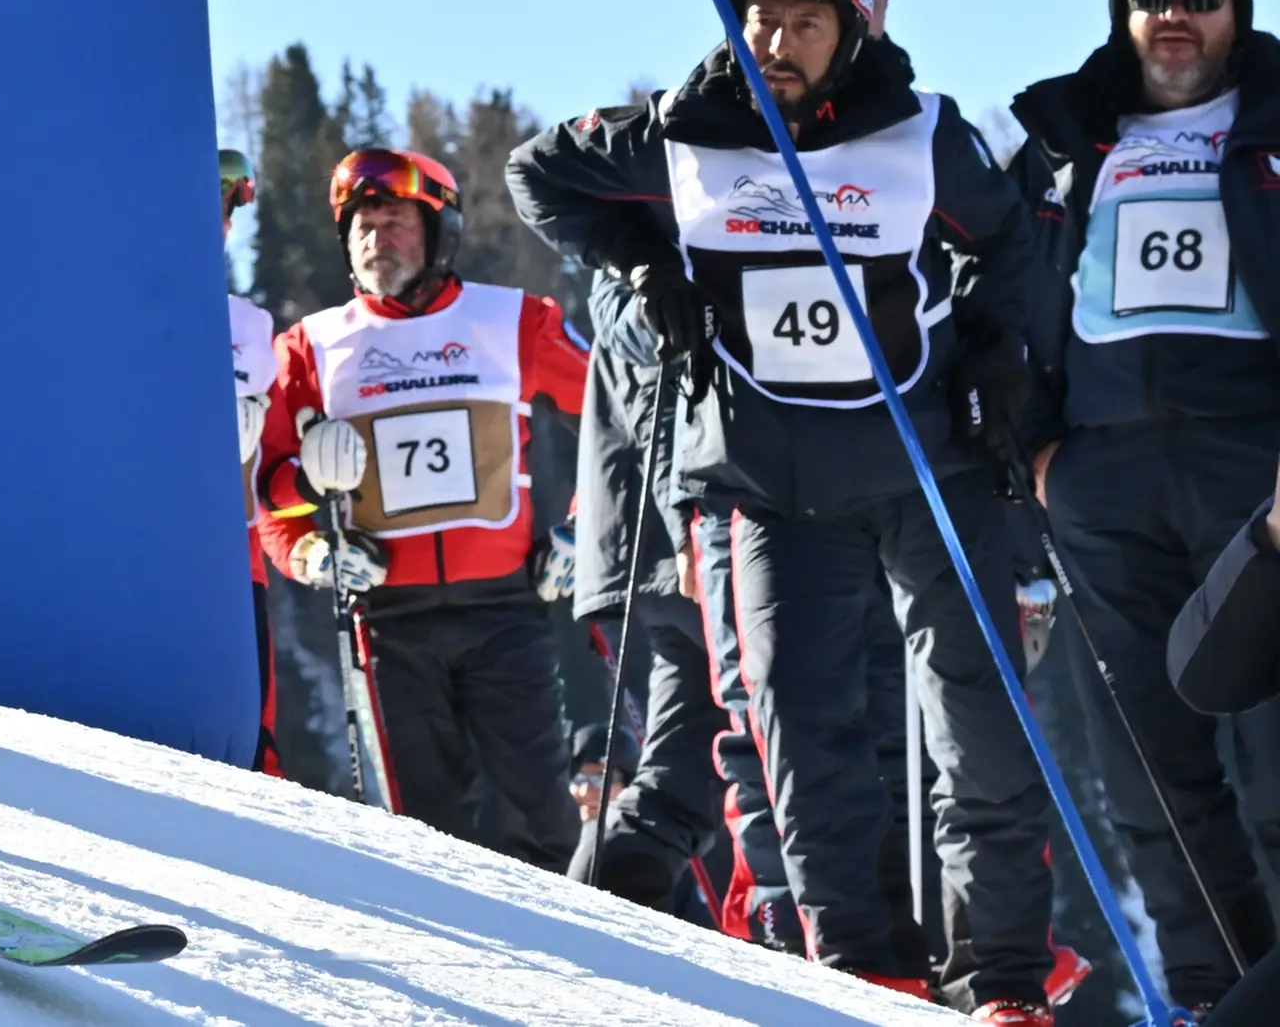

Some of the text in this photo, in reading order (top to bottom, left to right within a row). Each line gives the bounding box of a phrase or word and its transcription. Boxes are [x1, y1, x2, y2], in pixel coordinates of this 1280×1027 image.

[1140, 228, 1203, 271] 68
[704, 305, 715, 339] LEVEL
[772, 299, 840, 346] 49
[396, 437, 451, 477] 73
